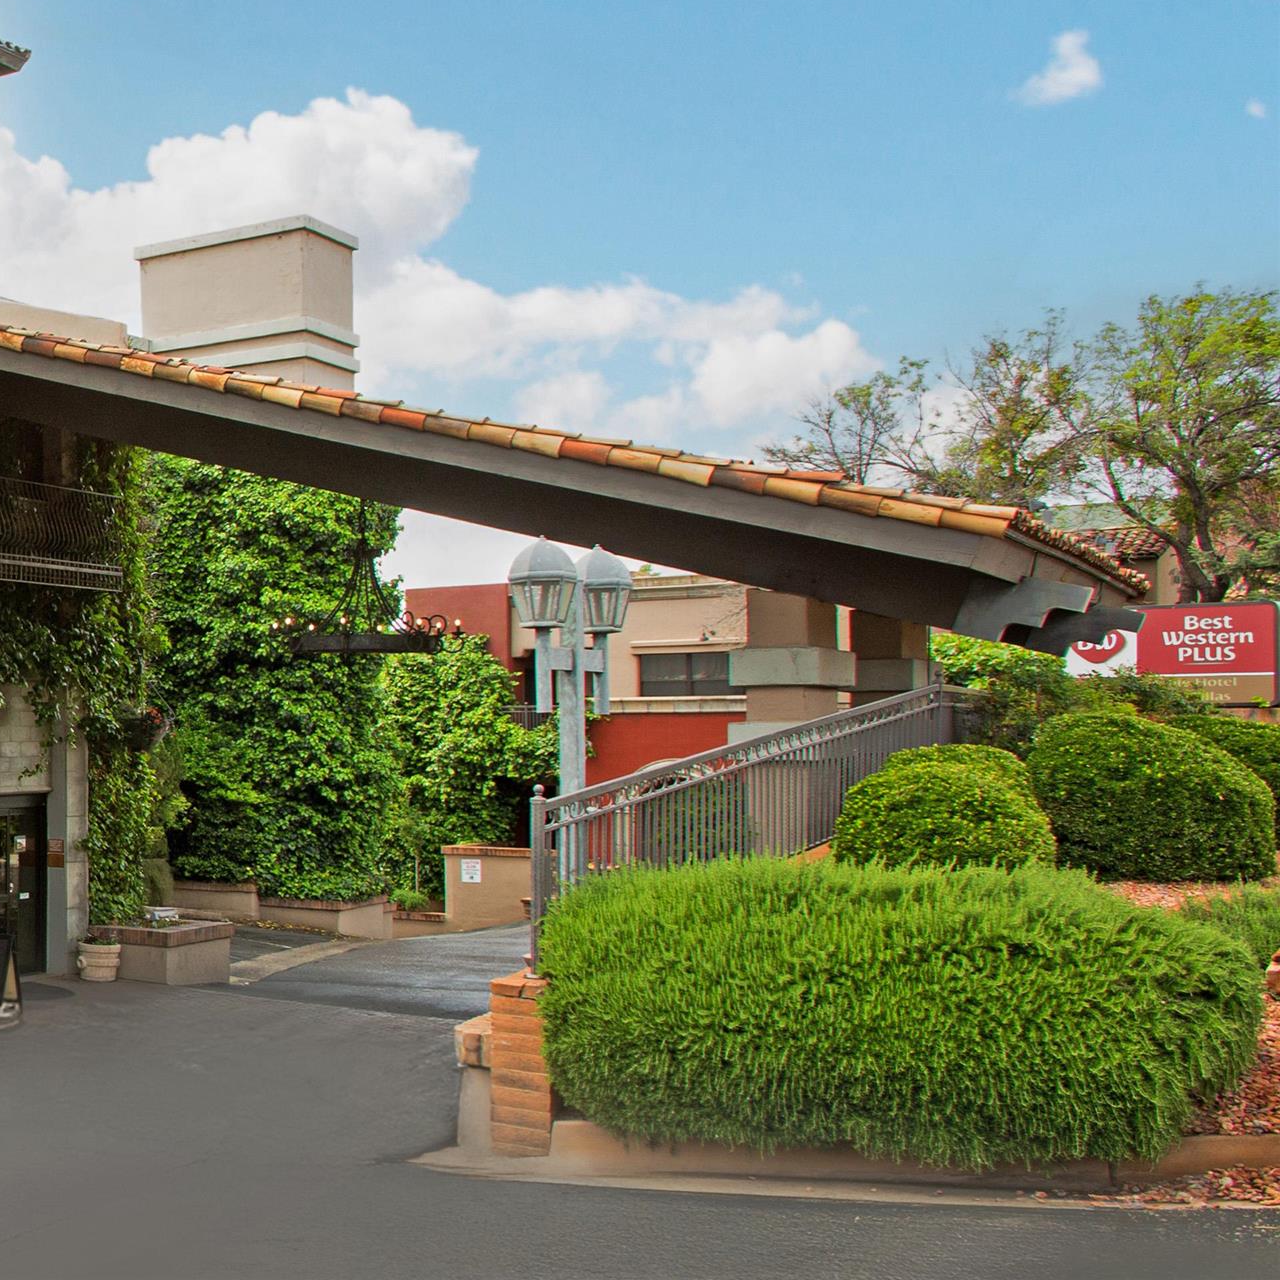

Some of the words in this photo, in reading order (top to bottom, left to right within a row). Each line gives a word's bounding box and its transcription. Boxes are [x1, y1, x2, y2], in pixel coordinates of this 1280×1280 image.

[1183, 615, 1233, 630] Best
[1162, 631, 1254, 646] Western
[1178, 646, 1236, 662] PLUS
[1196, 677, 1237, 687] Hotel
